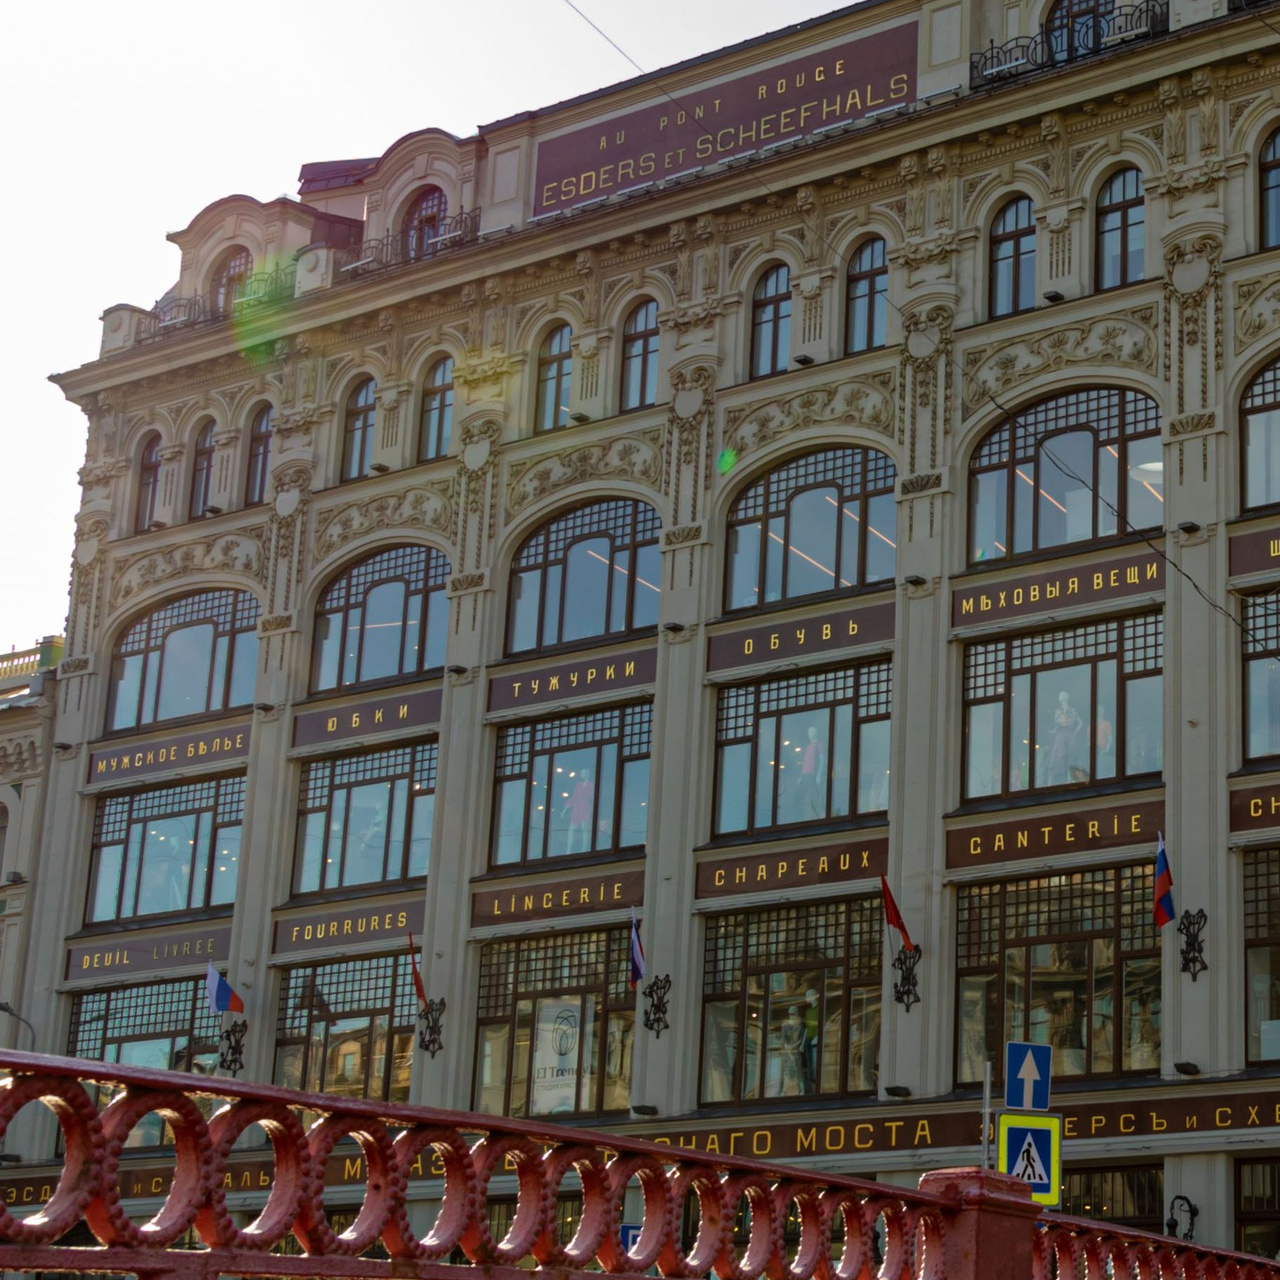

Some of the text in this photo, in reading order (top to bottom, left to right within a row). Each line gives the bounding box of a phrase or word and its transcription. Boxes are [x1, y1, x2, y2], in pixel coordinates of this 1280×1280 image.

[599, 59, 846, 151] AU PONT ROUGE
[541, 73, 909, 208] ESDERS ET SCHEEFHALS
[1092, 562, 1157, 591] ВЕЩИ
[744, 620, 858, 656] ОБУВЬ
[512, 661, 635, 698] ТУЖУРКИ
[327, 703, 408, 732] ЮБКИ
[97, 746, 177, 773] МУЖСКОЕ
[714, 850, 870, 887] CHAPEAUX
[292, 911, 407, 941] FOURRURES
[795, 1119, 931, 1152] МОСТА
[979, 1112, 1168, 1141] ЭЕРСЪ
